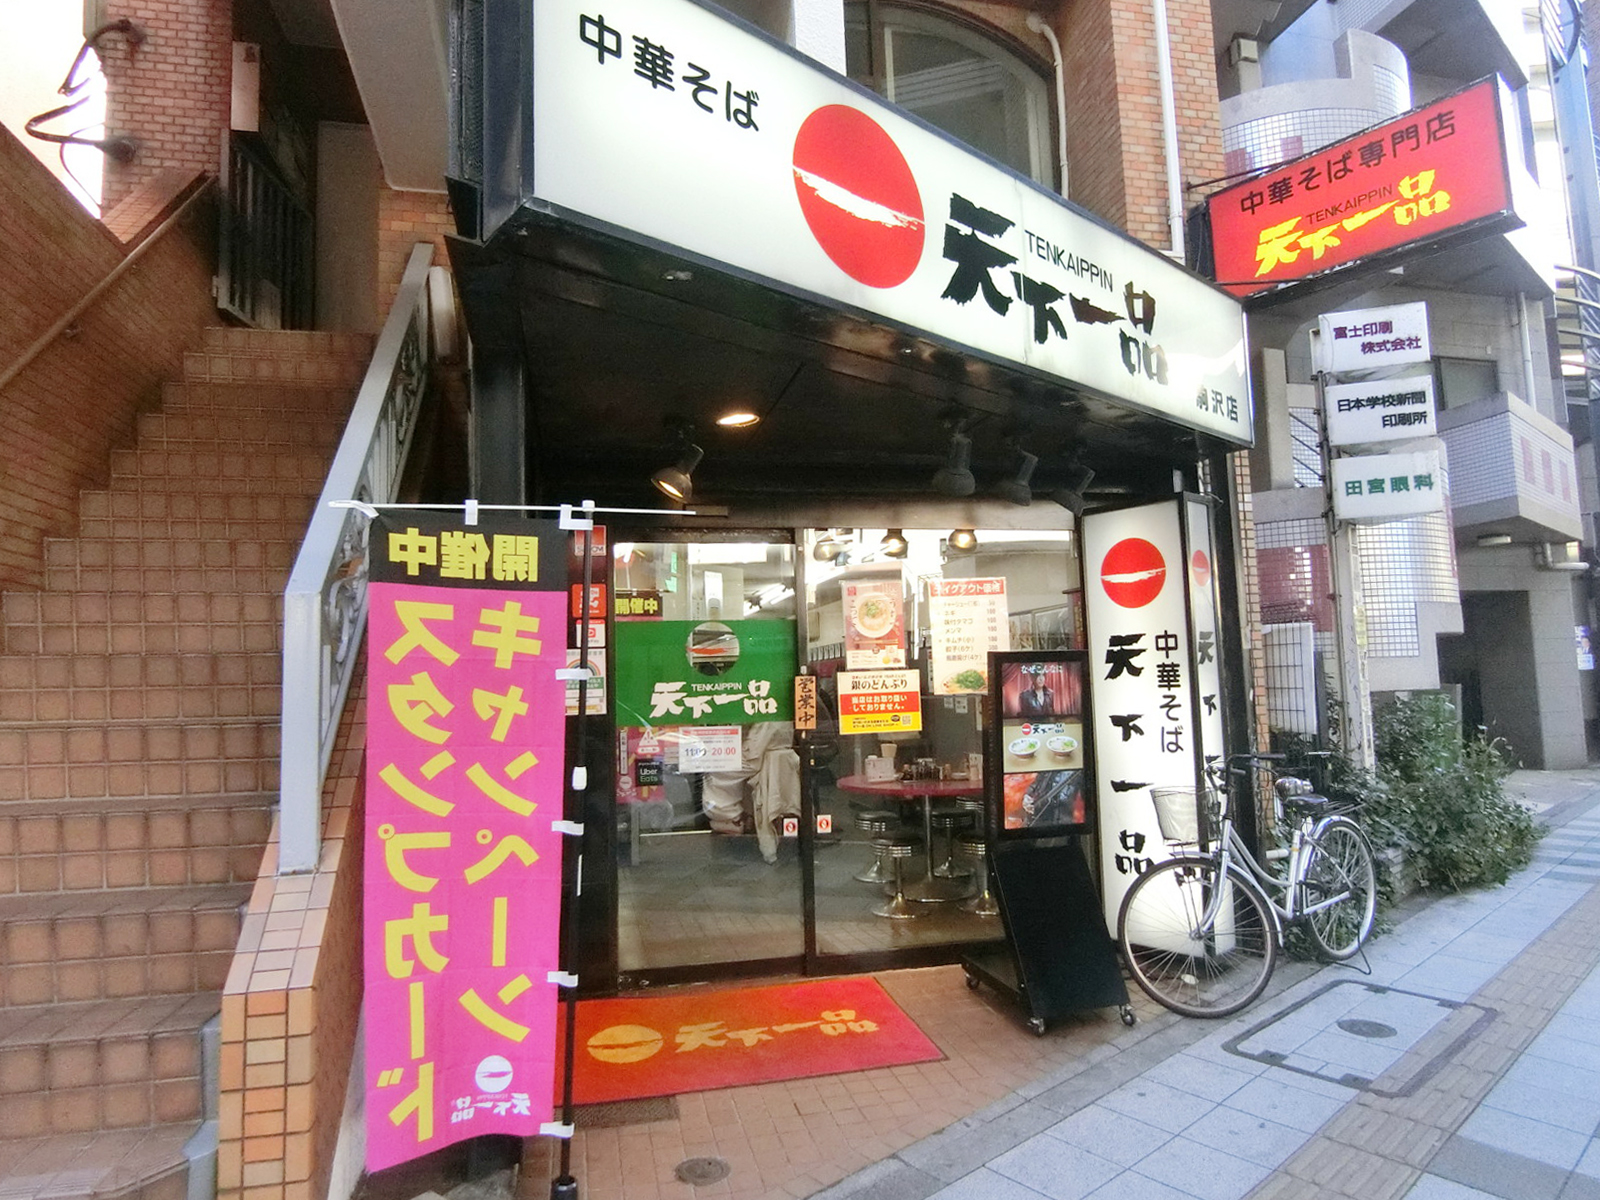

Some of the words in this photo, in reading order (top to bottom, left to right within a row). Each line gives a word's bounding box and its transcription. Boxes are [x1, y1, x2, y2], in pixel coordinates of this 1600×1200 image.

[579, 14, 760, 131] 中華そば
[1240, 109, 1456, 216] 中華そば専門店
[1255, 169, 1451, 278] 天下一品
[1306, 184, 1394, 226] TENKAIPPIN
[1024, 229, 1114, 293] TENKAIPPIN
[940, 192, 1169, 386] 天下一品
[1333, 320, 1393, 341] 富士印刷
[1361, 336, 1423, 355] 株式会社
[1337, 390, 1427, 412] 日本学校新聞
[1382, 411, 1428, 428] 印刷所
[615, 597, 658, 615] 開催中
[649, 679, 778, 719] 天下一品
[691, 682, 742, 692] TENKAIPPIN
[851, 679, 908, 691] 銀のどんぶり
[851, 694, 908, 704] 当店はお取り扱い
[1155, 630, 1185, 754] 中華そば
[852, 703, 905, 712] しておりません。
[1105, 633, 1154, 875] 天下一品
[674, 1009, 880, 1054] 天下一品
